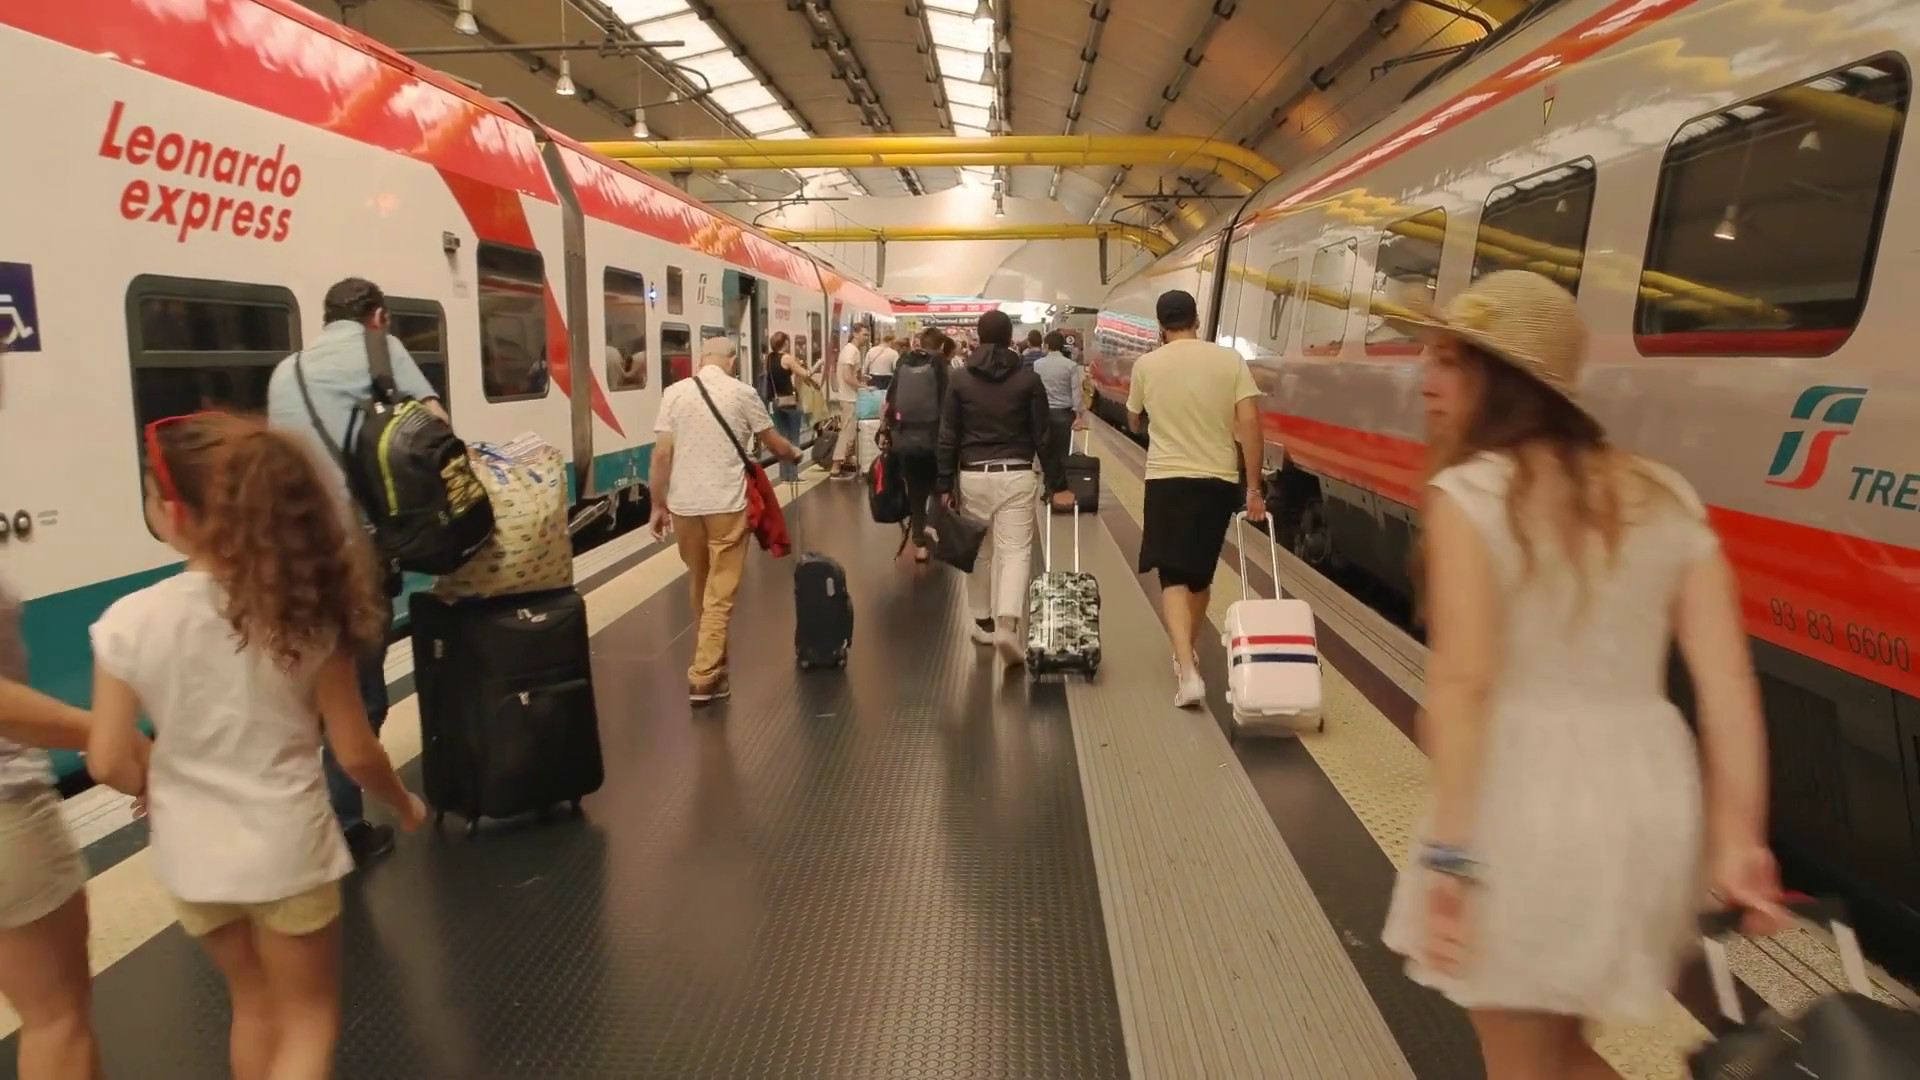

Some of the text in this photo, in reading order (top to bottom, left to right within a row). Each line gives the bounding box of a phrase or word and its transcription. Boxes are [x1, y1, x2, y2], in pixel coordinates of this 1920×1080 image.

[99, 101, 302, 197] Leonardo
[120, 179, 292, 243] express
[1848, 466, 1920, 513] TRE
[1770, 598, 1911, 672] 93 83 6600
